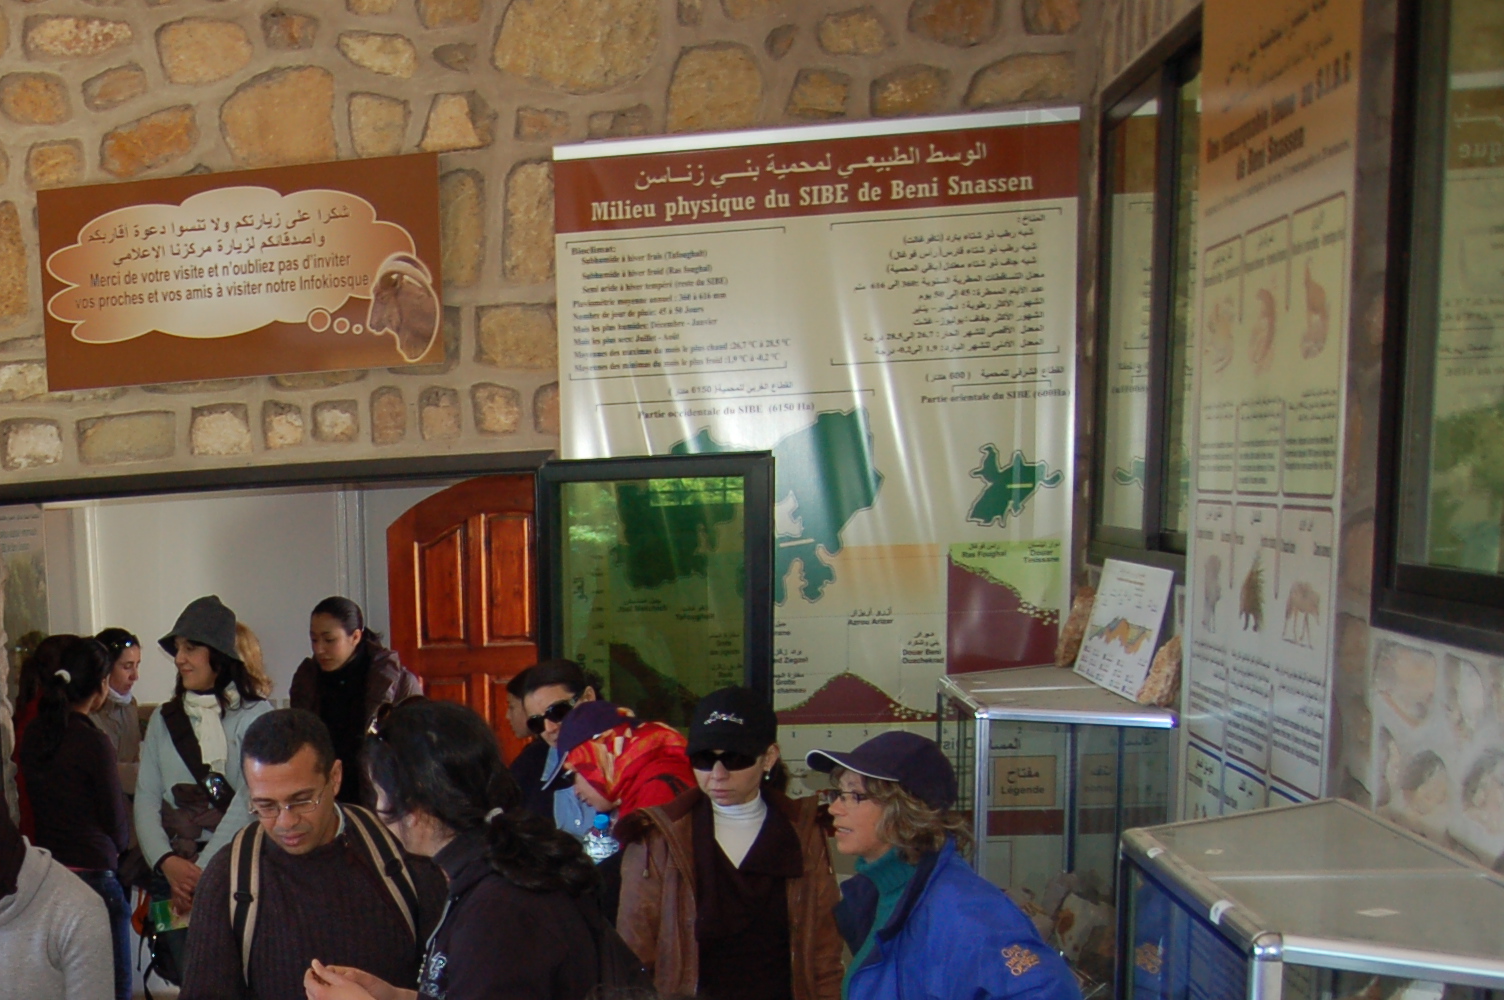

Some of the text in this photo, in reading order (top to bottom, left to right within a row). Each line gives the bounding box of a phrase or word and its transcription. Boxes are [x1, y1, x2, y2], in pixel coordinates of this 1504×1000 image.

[634, 141, 987, 190] الوسط الطبيعي لمحمية بني زناسن
[591, 175, 1034, 222] Milieu physique du SIBE de Beni Snassen
[235, 212, 281, 233] زيارتكم
[286, 209, 311, 229] على
[318, 205, 350, 224] شكرا
[133, 225, 167, 240] دعوة
[171, 219, 206, 237] تنسوا
[170, 243, 212, 259] مركزنا
[217, 236, 255, 255] لزيارة
[113, 246, 165, 267] الإعلامي
[90, 253, 351, 287] Merci de votre visite et n'oubliez pas d'inviter
[76, 273, 369, 311] vos proches et vos amis à visiter notre Infokiosque
[723, 406, 735, 415] du
[1000, 785, 1045, 797] Légende
